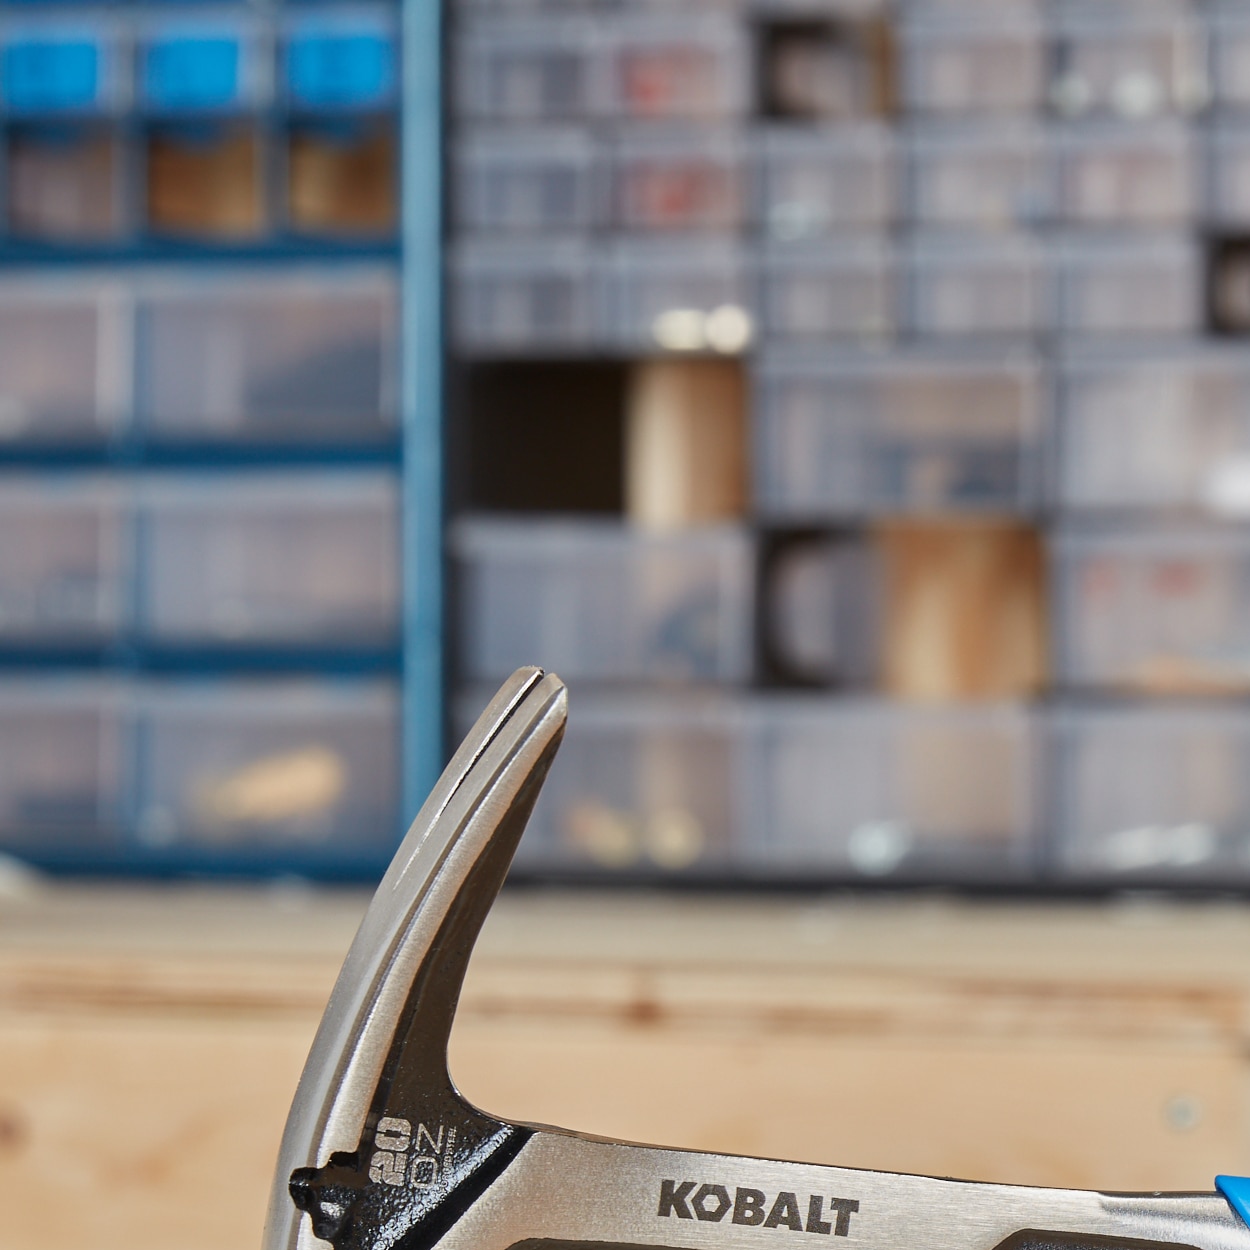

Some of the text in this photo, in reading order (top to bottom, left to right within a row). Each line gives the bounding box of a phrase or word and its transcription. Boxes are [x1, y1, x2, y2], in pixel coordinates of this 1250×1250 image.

[368, 1116, 412, 1187] 20
[409, 1122, 444, 1189] OZ
[657, 1179, 860, 1237] KOBALT
